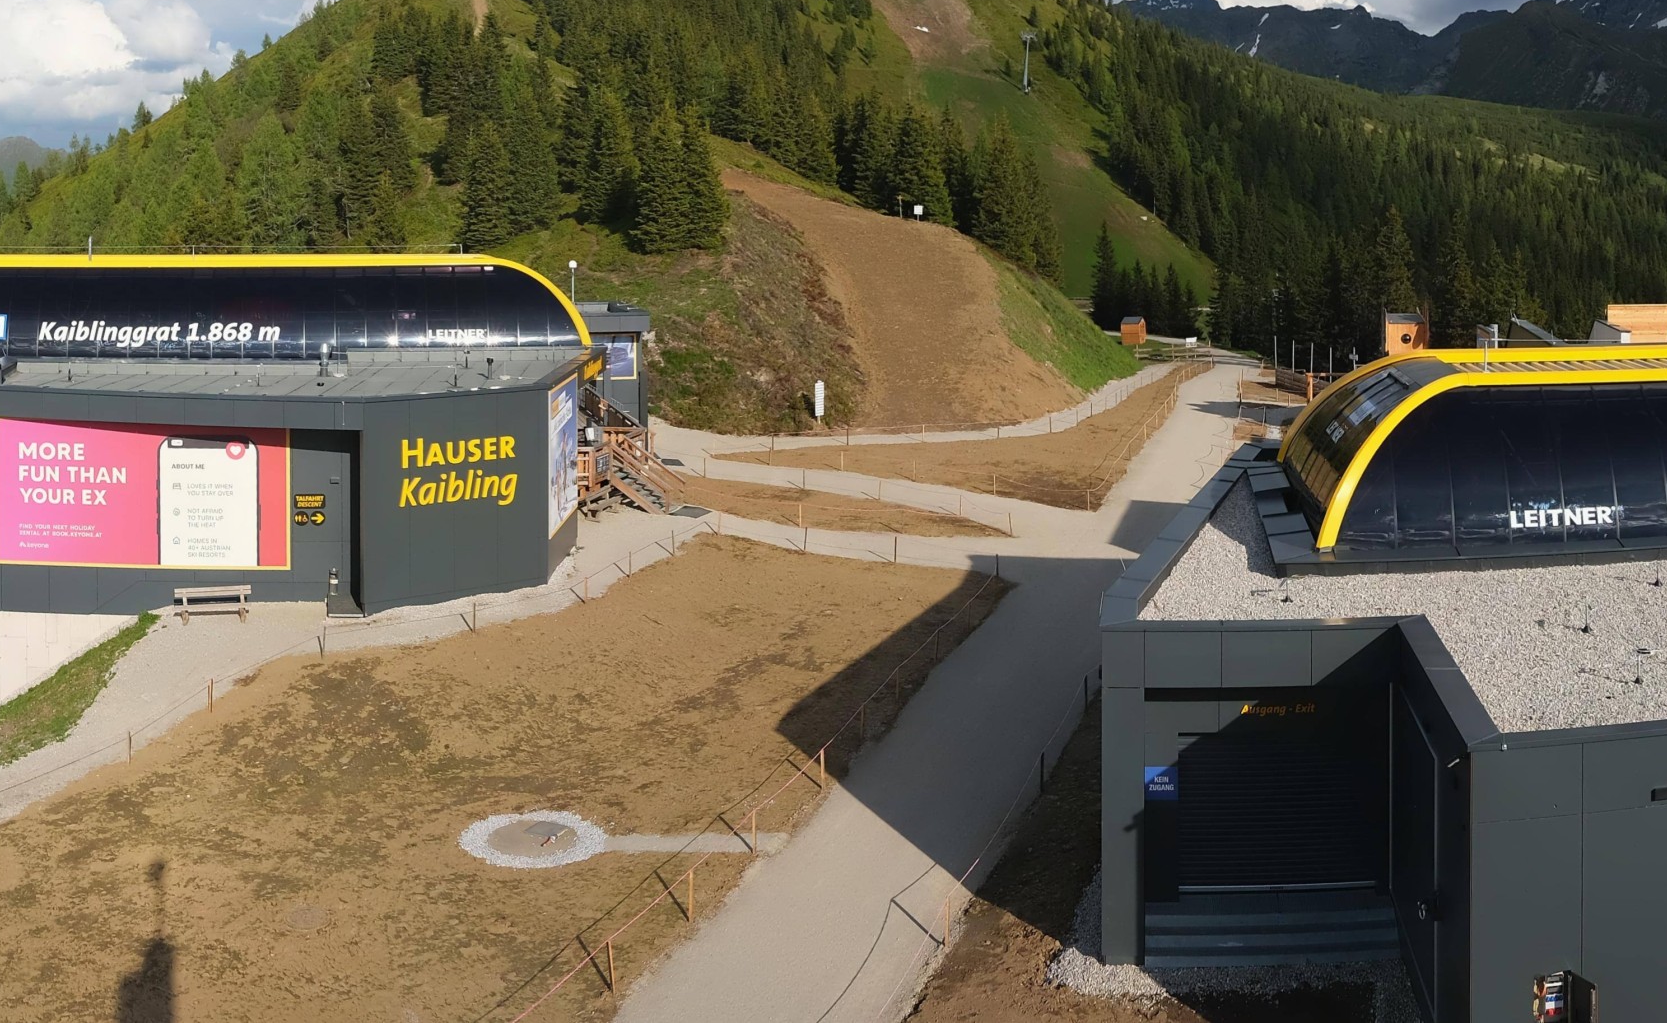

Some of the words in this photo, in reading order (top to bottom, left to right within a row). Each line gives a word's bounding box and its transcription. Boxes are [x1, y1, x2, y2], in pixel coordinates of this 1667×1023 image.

[38, 320, 181, 347] Kaiblinggrat
[186, 322, 253, 342] 1.868
[258, 326, 281, 341] m
[428, 328, 484, 339] LEITNER
[18, 442, 85, 461] MORE
[401, 435, 516, 469] HAUSER
[18, 465, 60, 483] FUN
[67, 466, 127, 484] THAN
[19, 487, 75, 505] YOUR
[81, 489, 107, 505] EX
[398, 469, 518, 508] Kaibling
[1510, 506, 1613, 528] LEITNER
[1241, 705, 1287, 716] Ausgang
[1295, 704, 1315, 713] Exit
